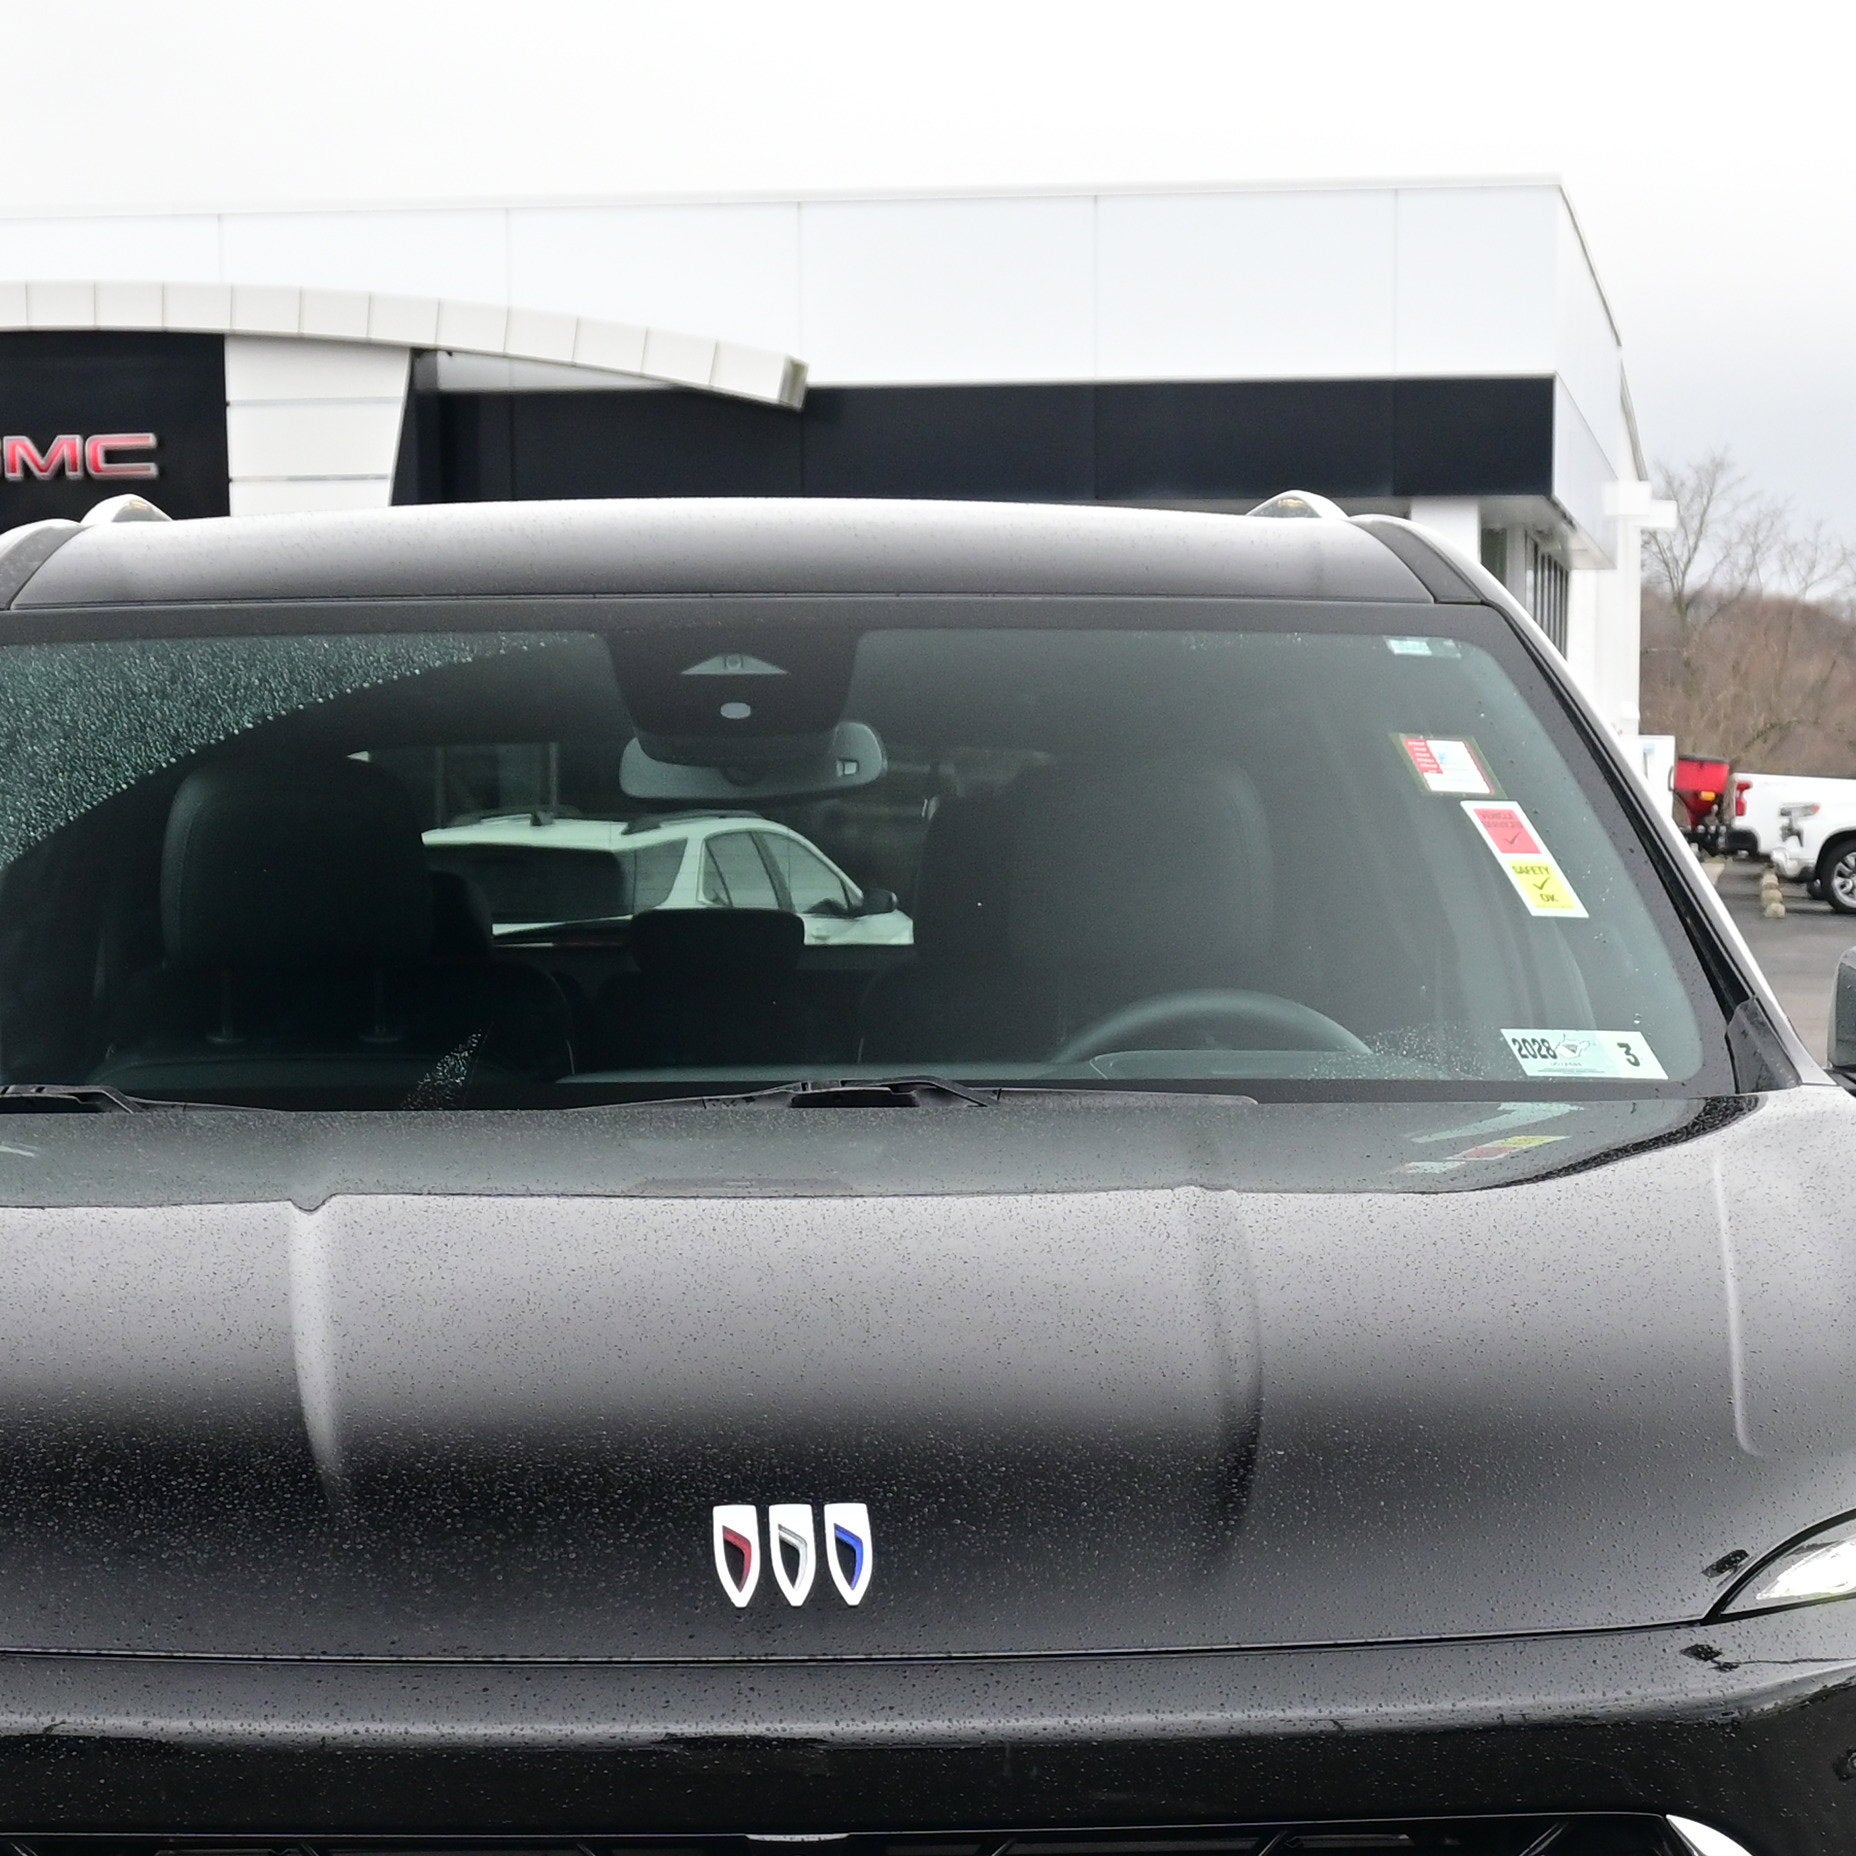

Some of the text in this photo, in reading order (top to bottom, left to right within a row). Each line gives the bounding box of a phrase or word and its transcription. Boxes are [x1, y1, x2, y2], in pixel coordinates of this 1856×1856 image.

[1511, 865, 1551, 875] SAFETY
[1511, 1037, 1641, 1067] 2028 3
